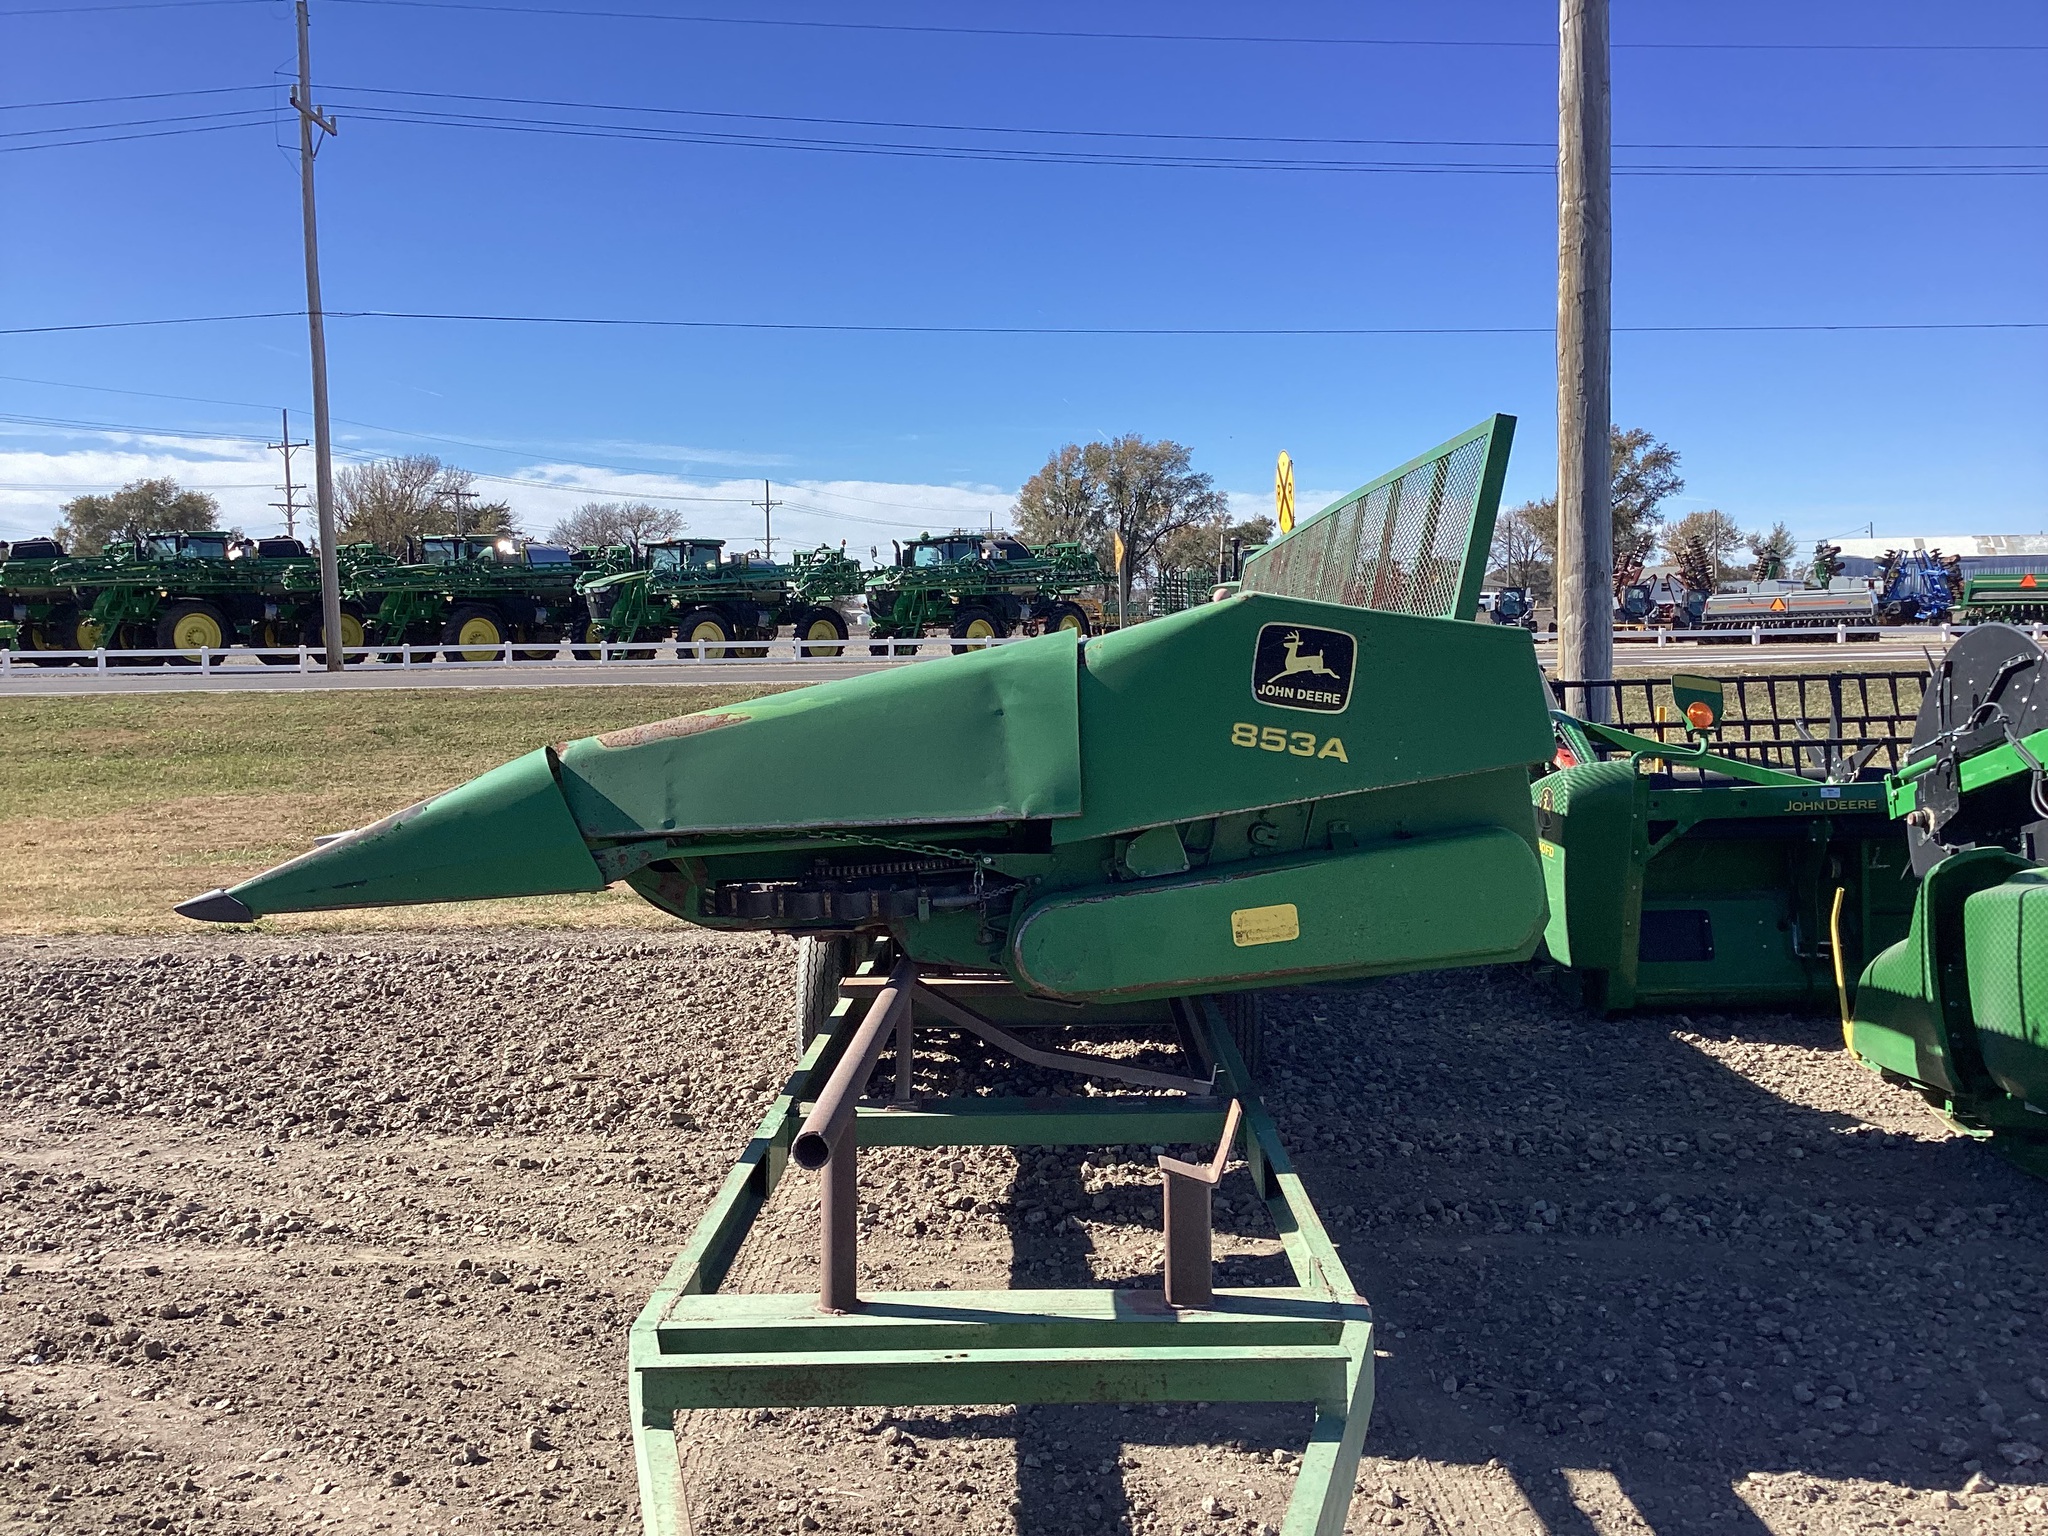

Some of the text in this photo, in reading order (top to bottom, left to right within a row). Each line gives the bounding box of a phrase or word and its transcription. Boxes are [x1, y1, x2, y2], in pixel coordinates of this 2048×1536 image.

[1258, 684, 1341, 704] JOHN DEERE
[1231, 722, 1349, 764] 853A
[1784, 799, 1877, 812] JOHN DEERE
